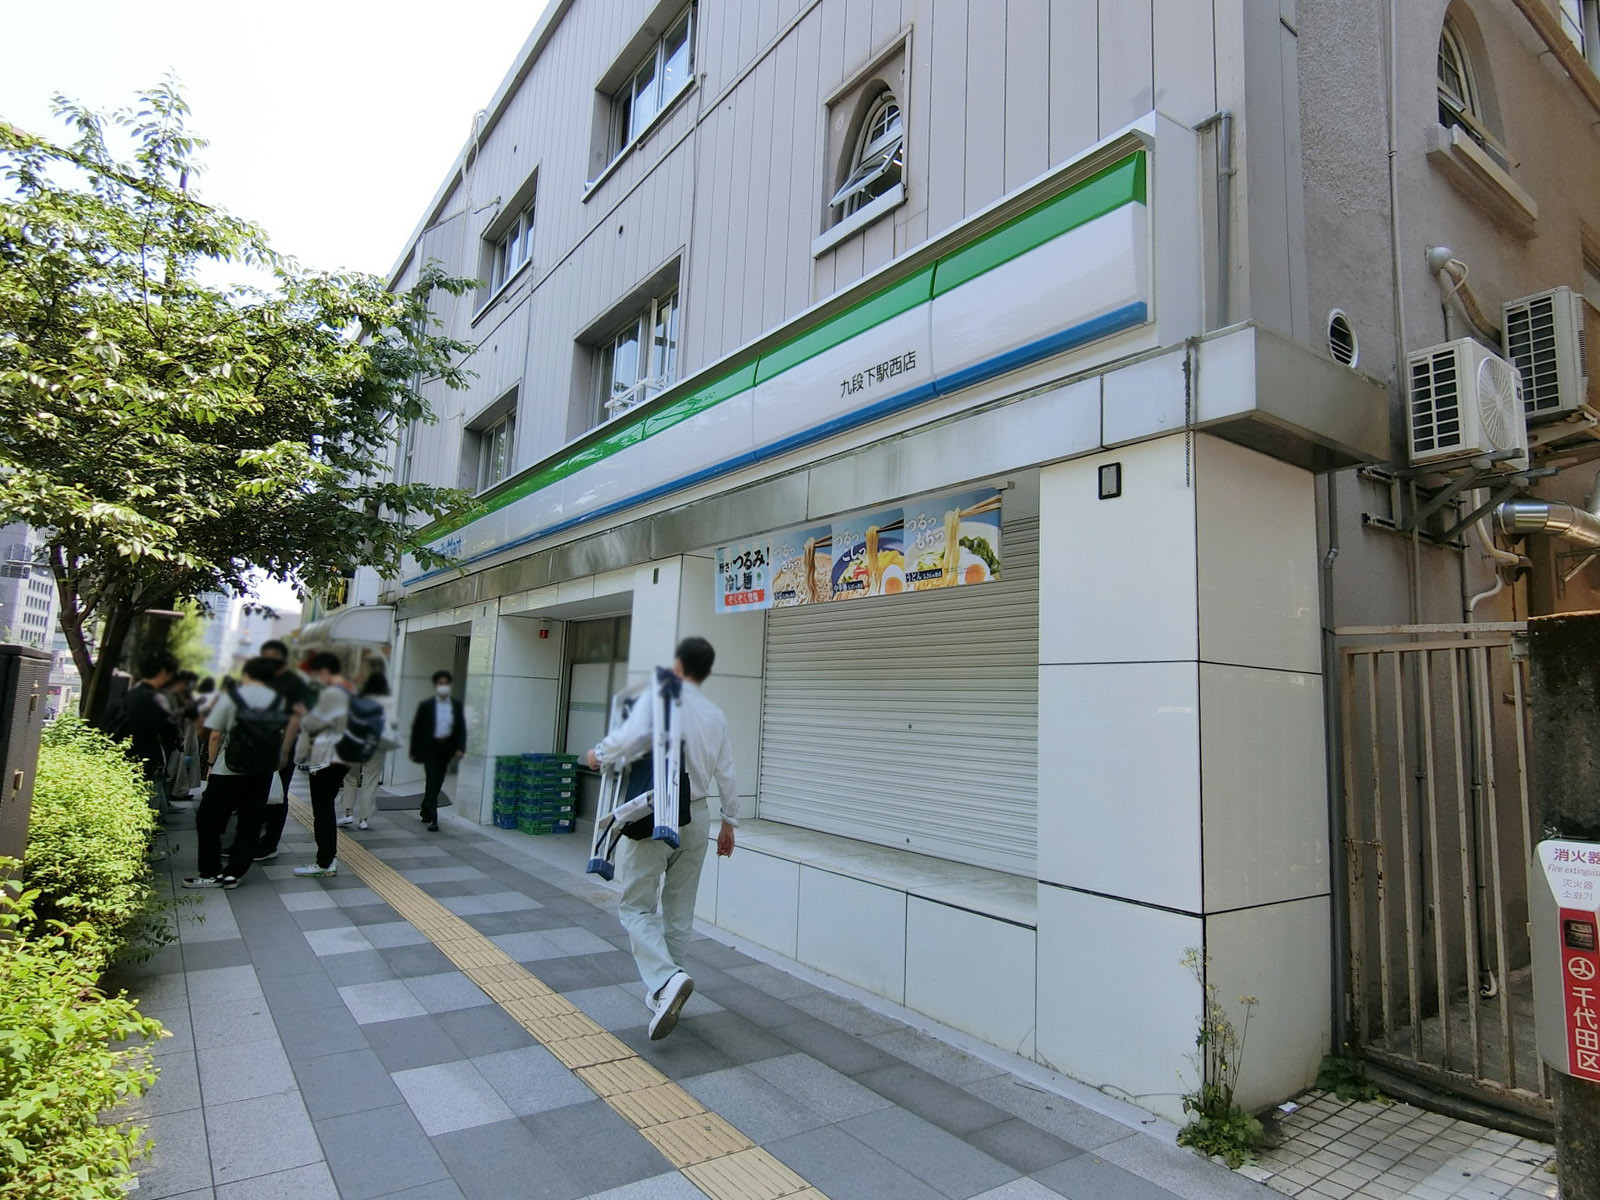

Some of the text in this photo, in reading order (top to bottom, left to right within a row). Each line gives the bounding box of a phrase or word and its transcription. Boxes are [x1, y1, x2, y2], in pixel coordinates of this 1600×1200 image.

[840, 350, 916, 398] 九段下駅西店
[725, 571, 753, 593] 冷し麺
[1554, 848, 1600, 865] 消火器
[1547, 864, 1600, 877] Fire extinguis
[1572, 986, 1600, 1073] 千代田区
